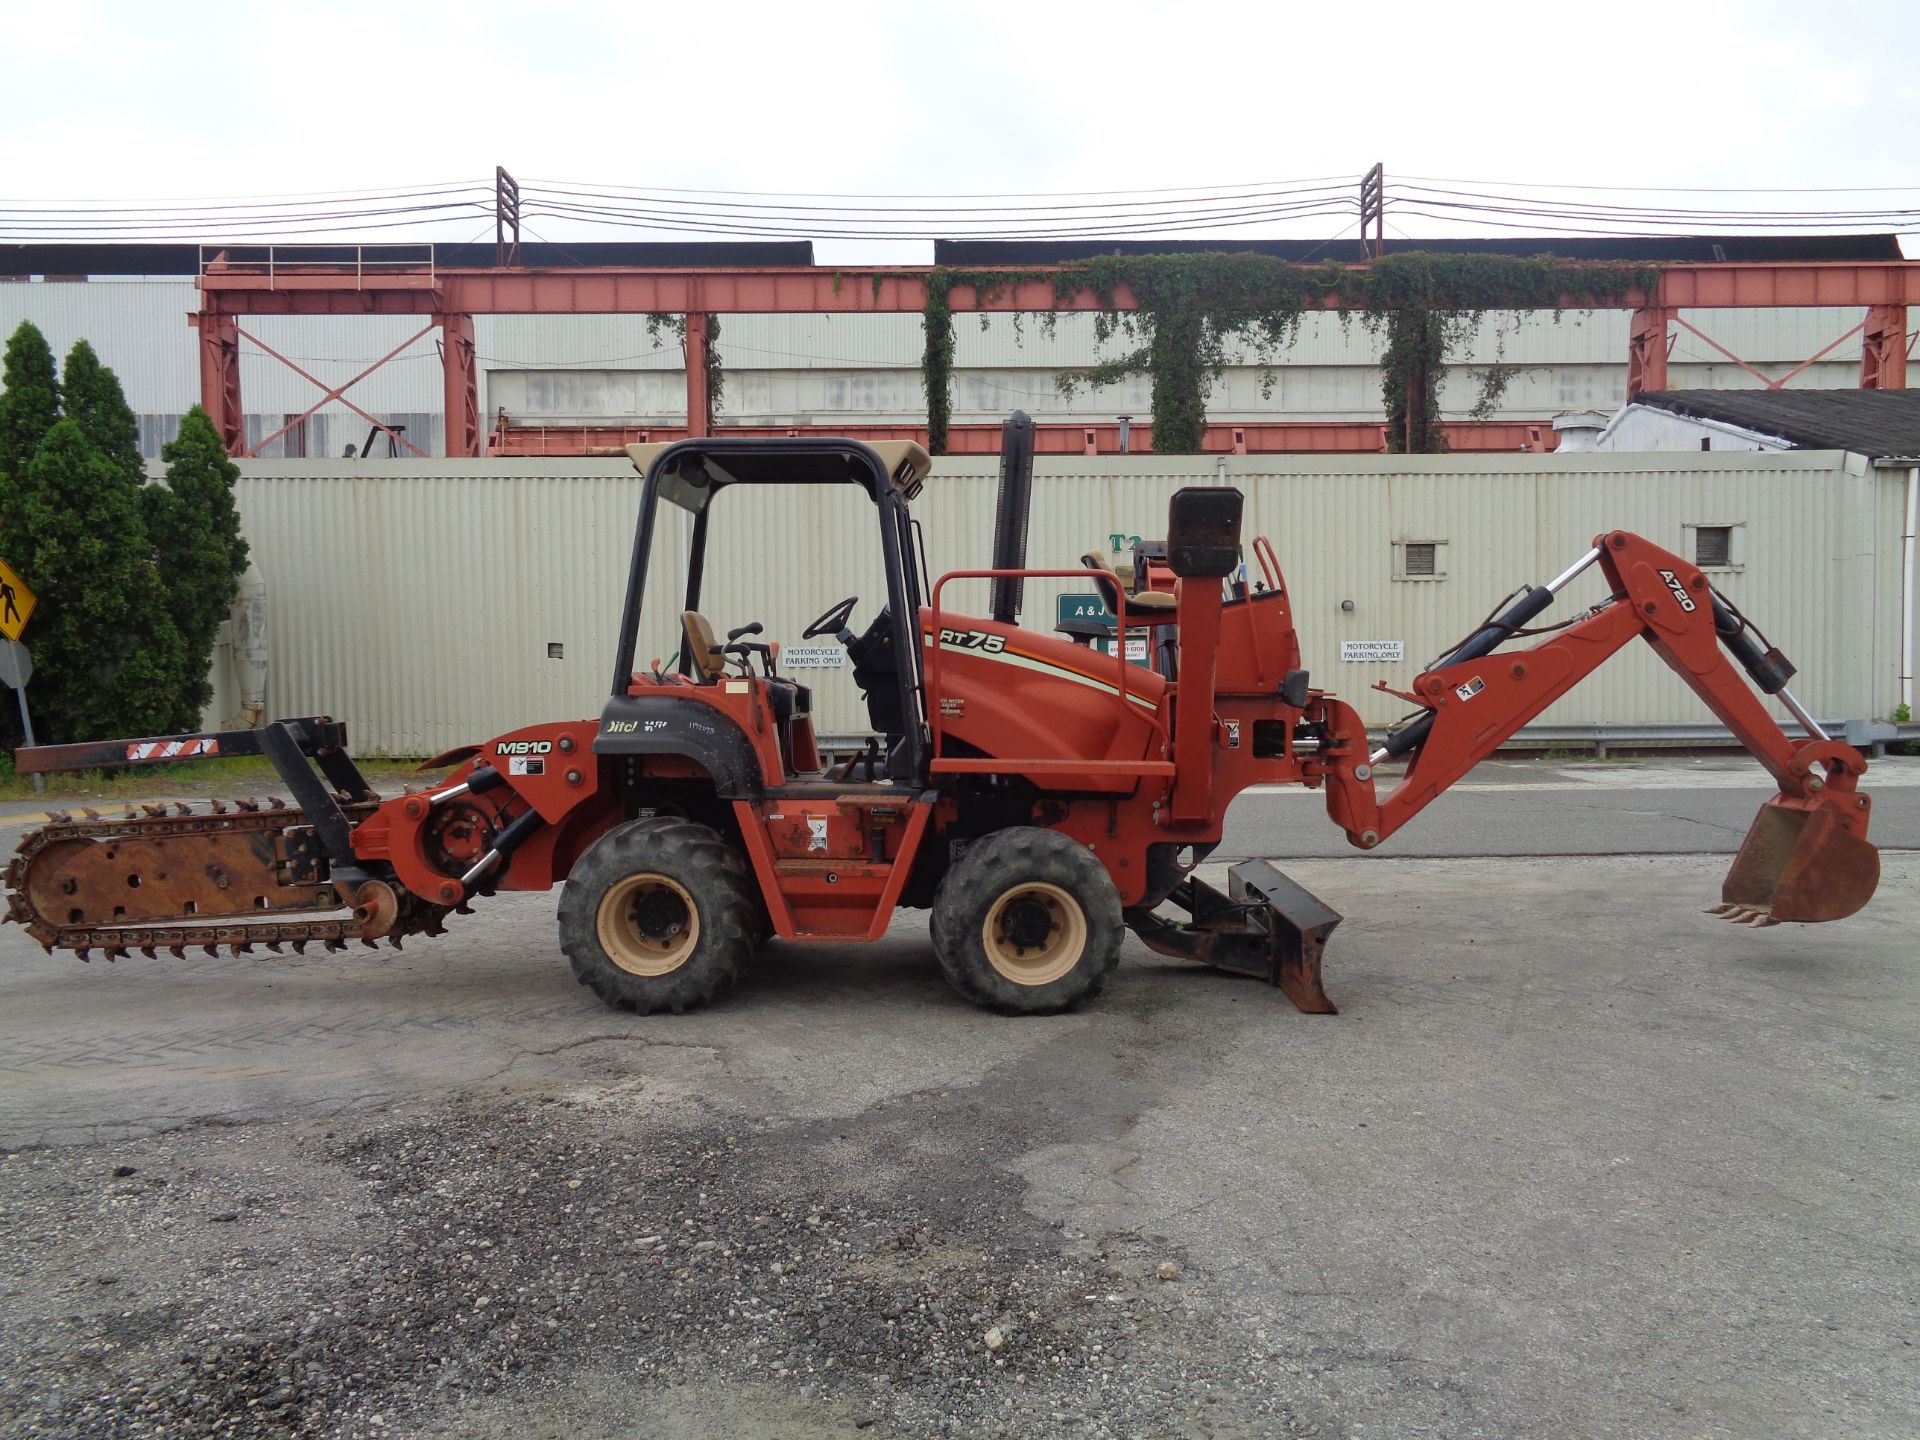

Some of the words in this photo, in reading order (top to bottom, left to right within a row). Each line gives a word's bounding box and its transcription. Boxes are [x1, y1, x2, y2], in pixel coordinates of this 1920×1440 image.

[1657, 569, 1697, 613] A720
[1075, 605, 1084, 616] A
[1087, 605, 1095, 616] &
[939, 629, 1007, 653] RT75
[787, 648, 840, 656] MOTORCYCLE
[1344, 651, 1379, 659] PARKING
[1381, 651, 1401, 659] ONLY
[785, 657, 820, 665] PARKING
[822, 657, 843, 665] ONLY
[496, 740, 553, 756] M910
